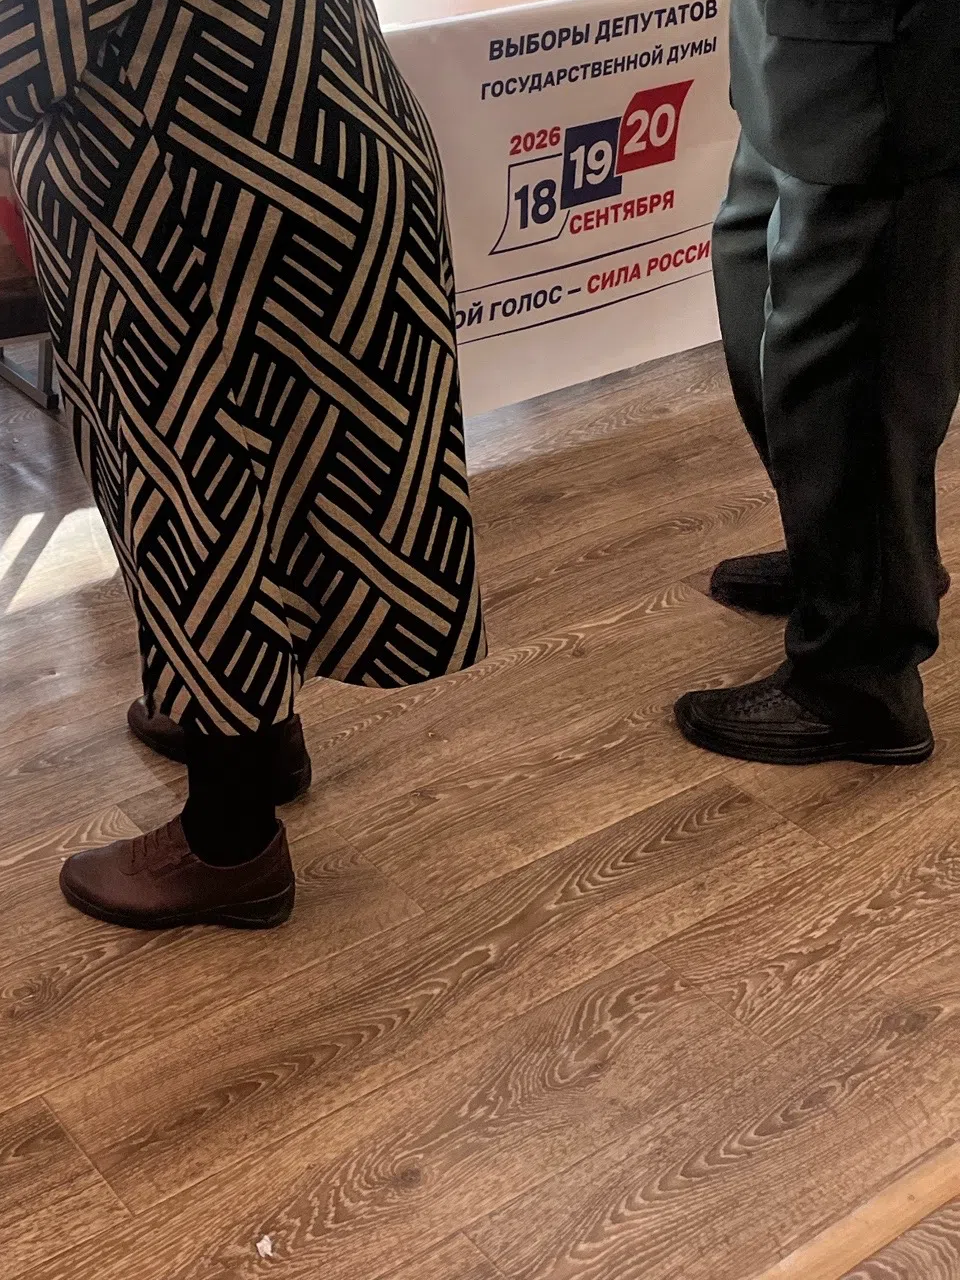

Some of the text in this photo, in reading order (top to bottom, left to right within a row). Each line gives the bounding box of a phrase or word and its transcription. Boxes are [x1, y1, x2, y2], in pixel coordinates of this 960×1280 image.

[480, 36, 718, 100] ГОСУДАРСТВЕННОЙ ДУМЫ
[489, 23, 591, 61] ВЫБОРЫ
[509, 126, 562, 156] 2026
[514, 102, 677, 230] 18 19 20
[569, 189, 675, 235] СЕНТЯБРЯ
[455, 302, 485, 330] ОЙ
[489, 285, 563, 322] ГОЛОС
[587, 263, 641, 294] СИЛА
[646, 240, 712, 277] РОССИ
